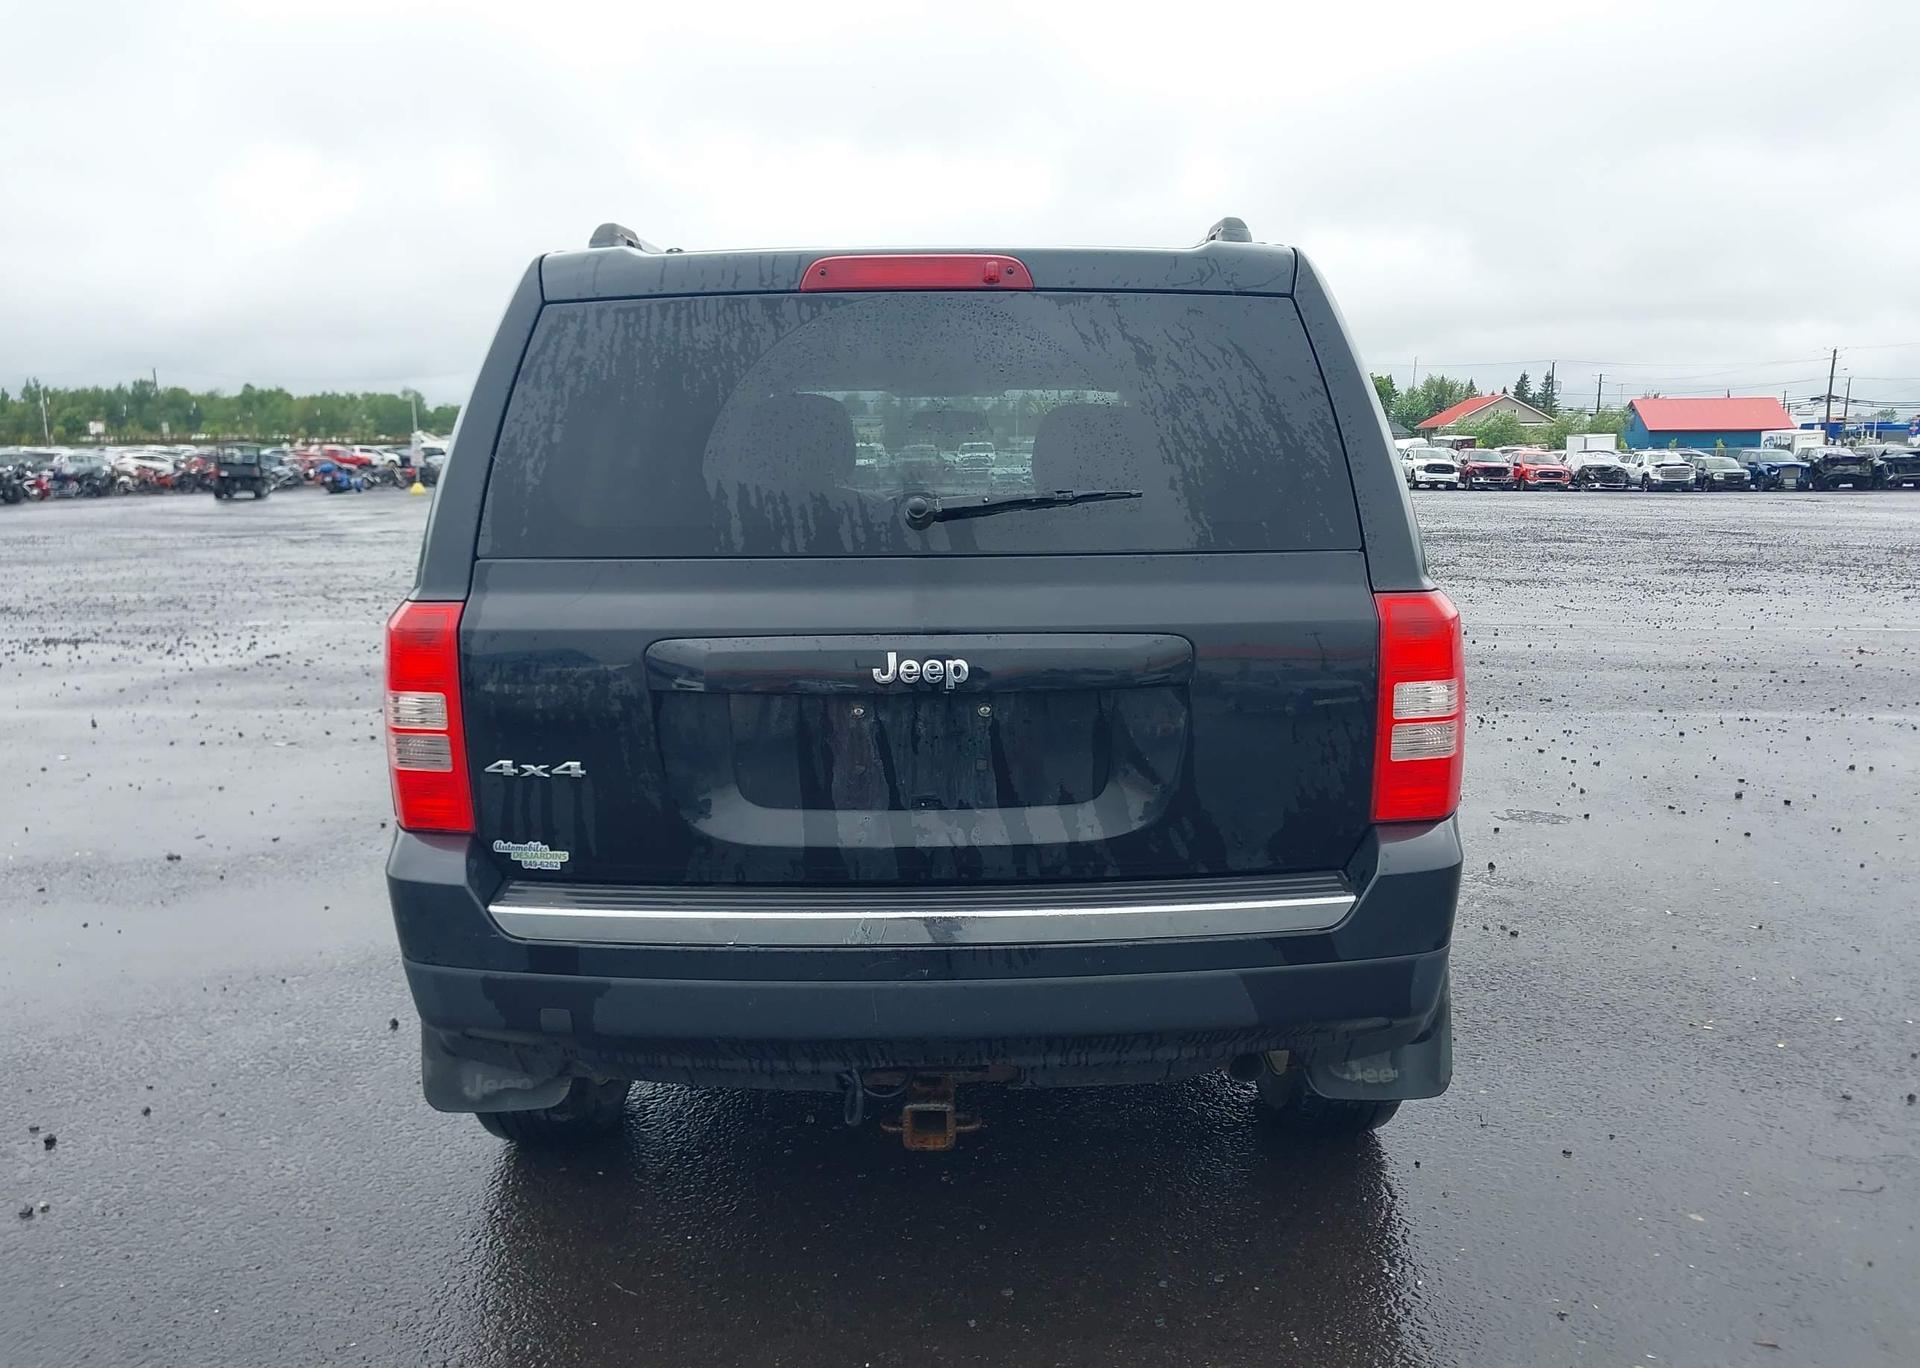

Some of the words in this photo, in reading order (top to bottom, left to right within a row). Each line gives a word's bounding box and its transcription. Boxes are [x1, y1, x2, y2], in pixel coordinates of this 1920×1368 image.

[872, 651, 969, 689] Jeep
[484, 760, 587, 778] 4x4
[494, 841, 548, 853] Automobiles
[512, 851, 568, 861] DESJARDINS
